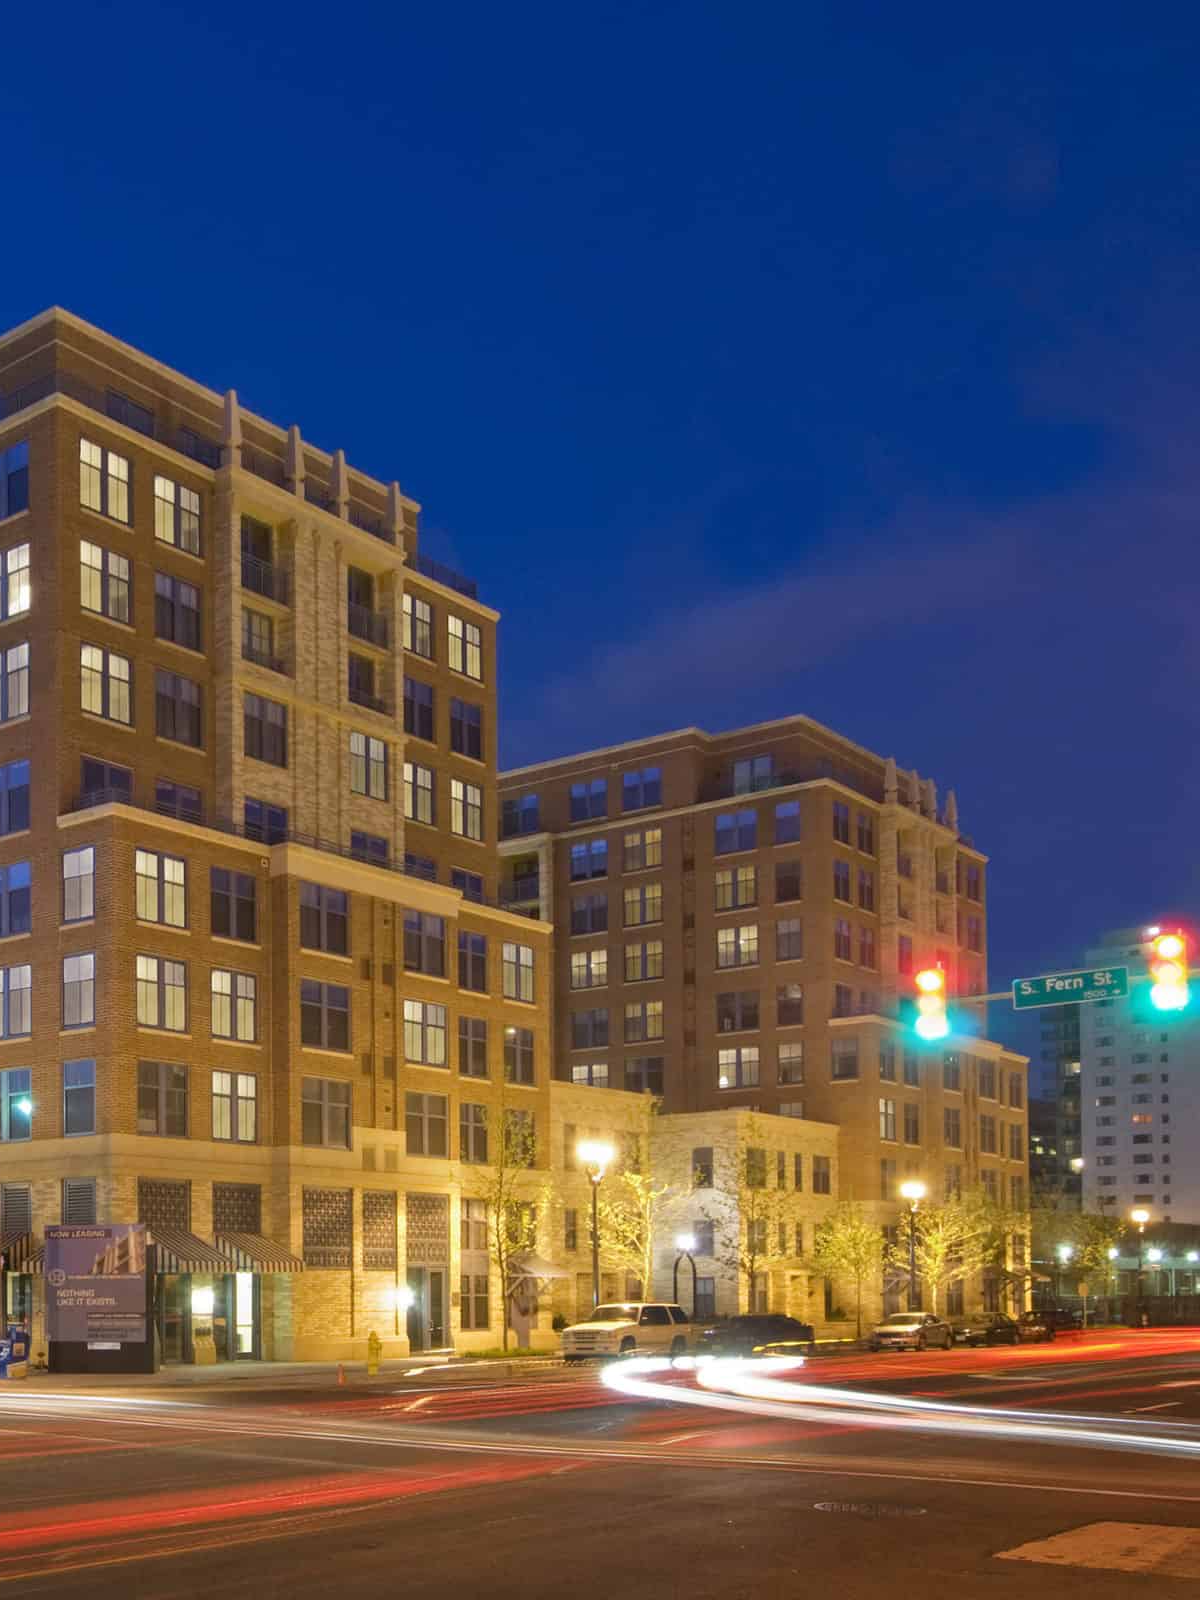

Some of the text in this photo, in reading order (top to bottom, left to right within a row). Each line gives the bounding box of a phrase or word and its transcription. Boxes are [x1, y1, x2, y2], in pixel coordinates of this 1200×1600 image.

[1046, 977, 1083, 992] Fern
[1093, 972, 1117, 986] St.
[72, 1230, 105, 1238] LEASING
[56, 1288, 96, 1297] NOTHING
[56, 1298, 76, 1306] LIKE
[77, 1297, 85, 1306] IT
